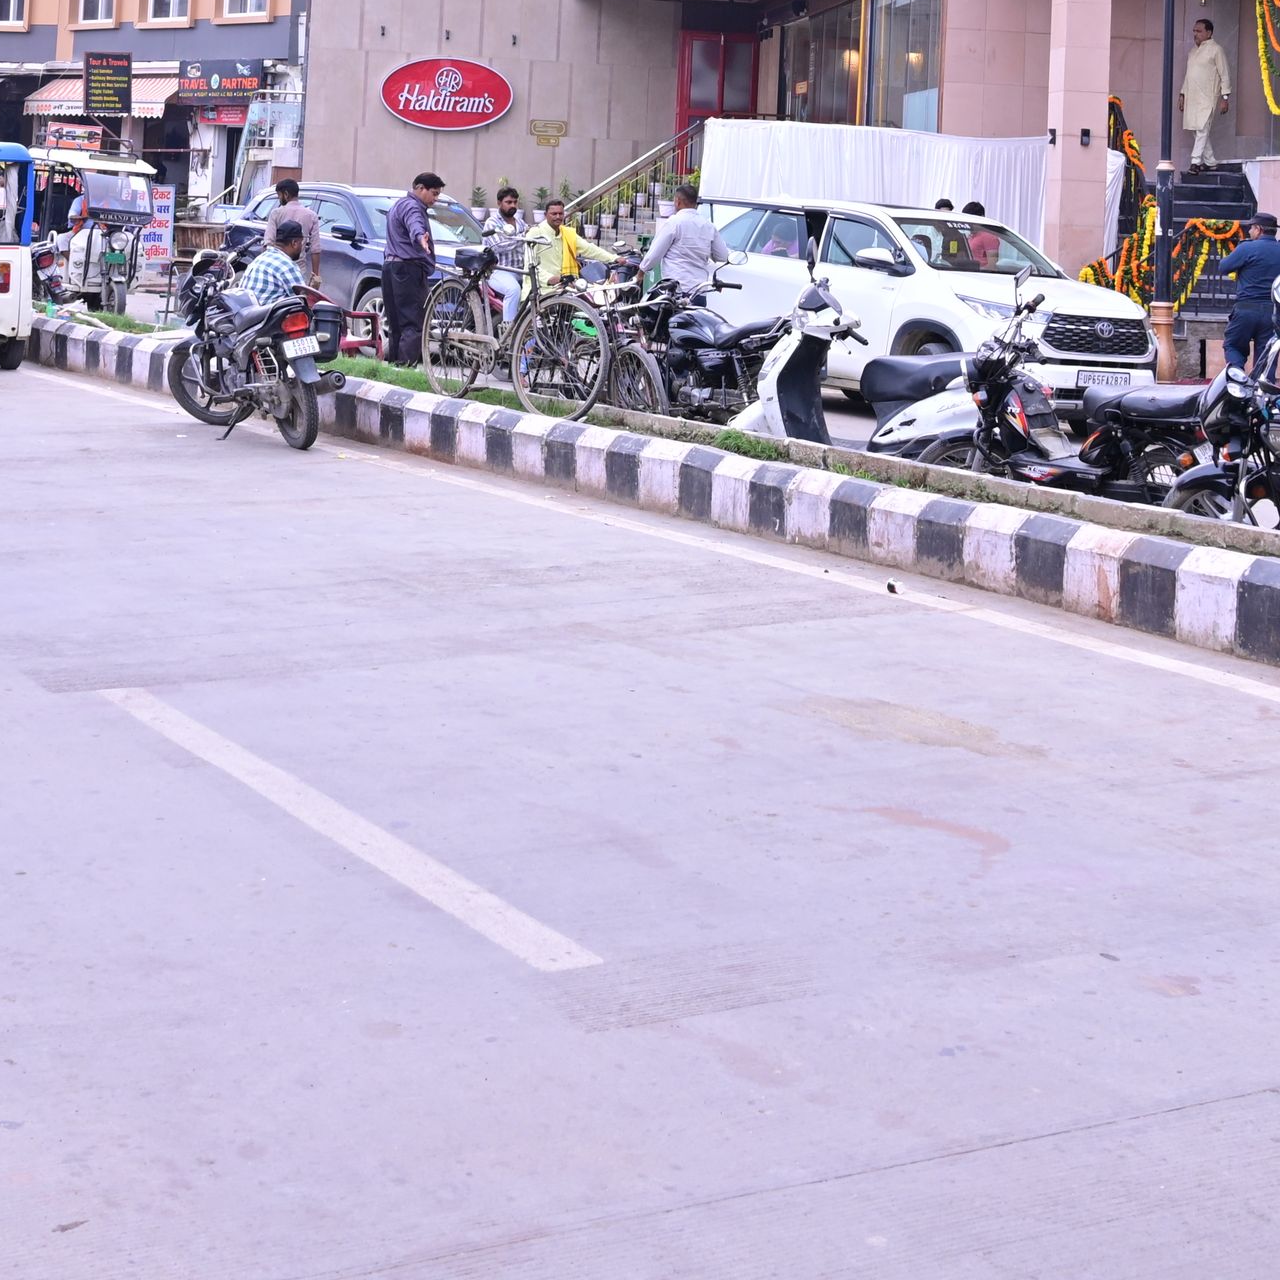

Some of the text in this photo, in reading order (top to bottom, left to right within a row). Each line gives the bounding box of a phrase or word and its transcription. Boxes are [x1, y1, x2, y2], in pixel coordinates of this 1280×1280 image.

[180, 77, 258, 90] TRAVEL PARTNER
[398, 83, 495, 113] Haldiram's
